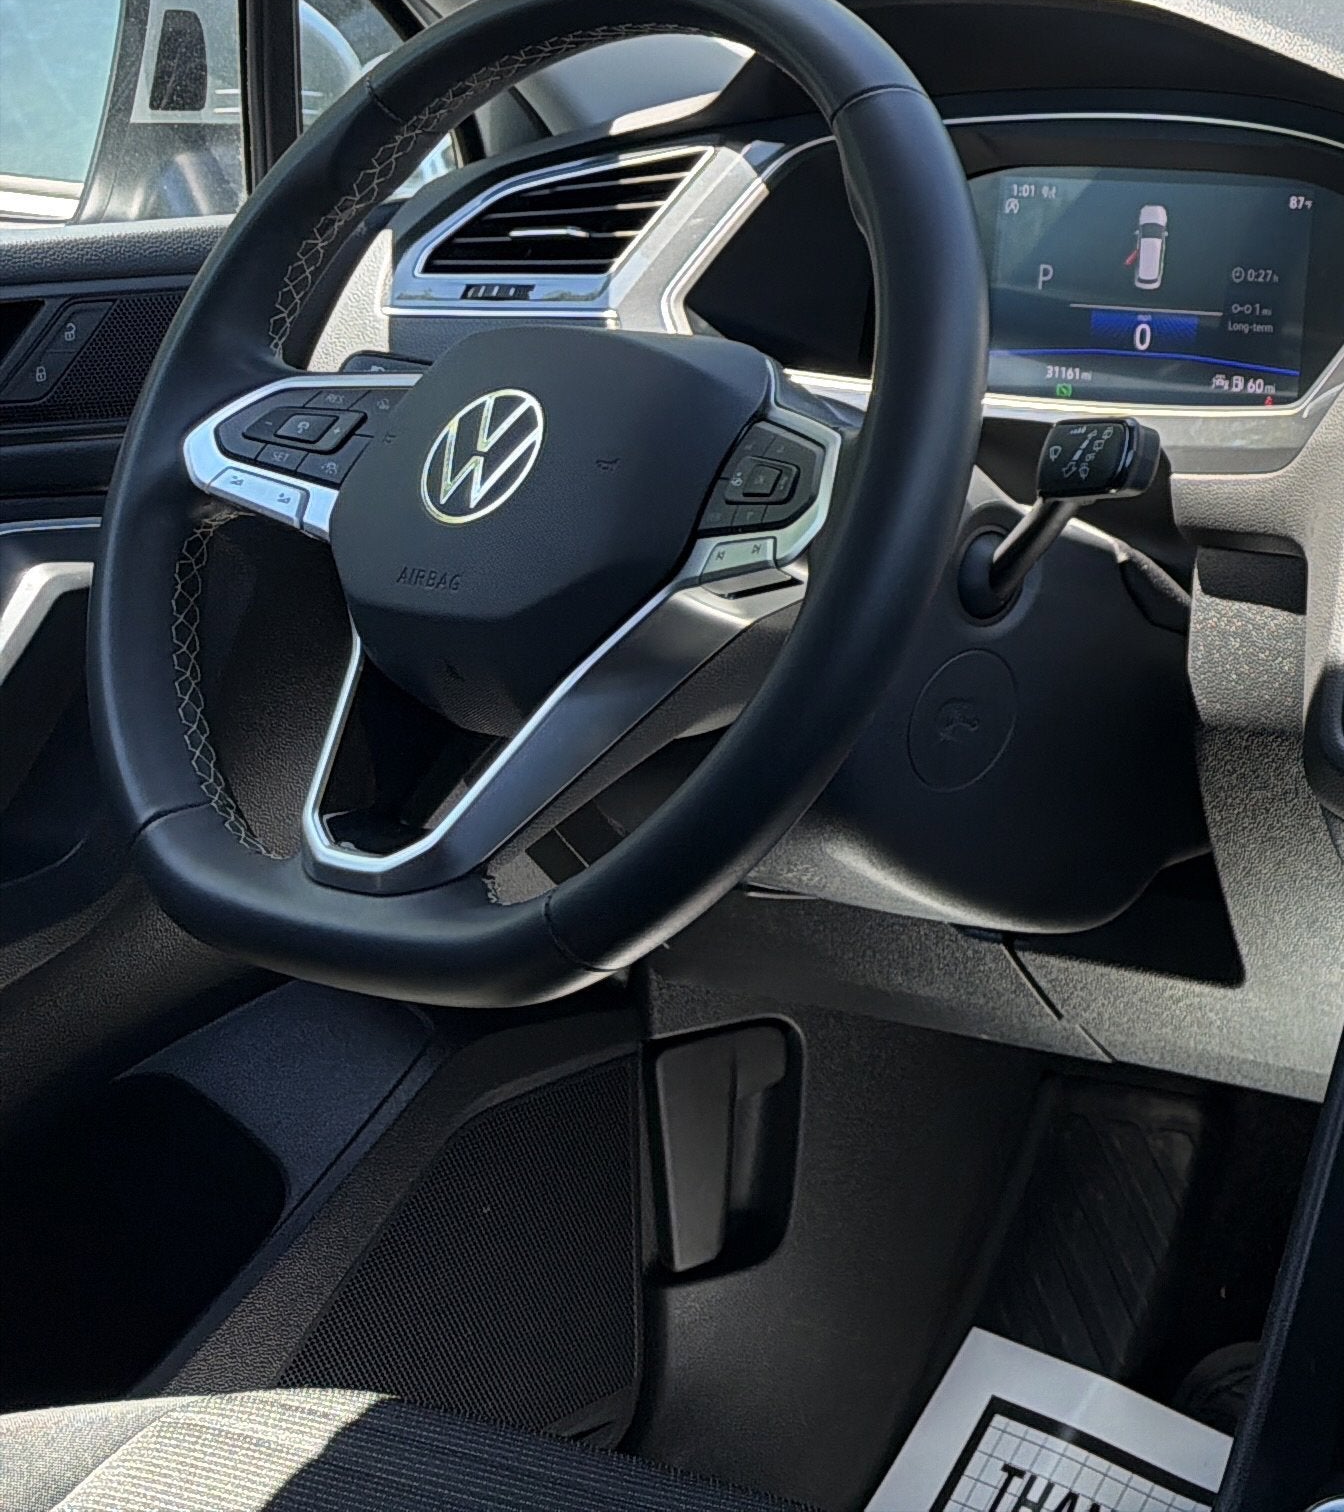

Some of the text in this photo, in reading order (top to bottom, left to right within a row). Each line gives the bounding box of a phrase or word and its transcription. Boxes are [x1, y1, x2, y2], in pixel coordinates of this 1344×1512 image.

[1013, 184, 1035, 197] 1:01
[1038, 264, 1053, 290] P
[1134, 324, 1151, 350] 0
[1228, 321, 1273, 334] Long-term
[273, 451, 290, 462] SET
[396, 566, 462, 591] AIRBAG
